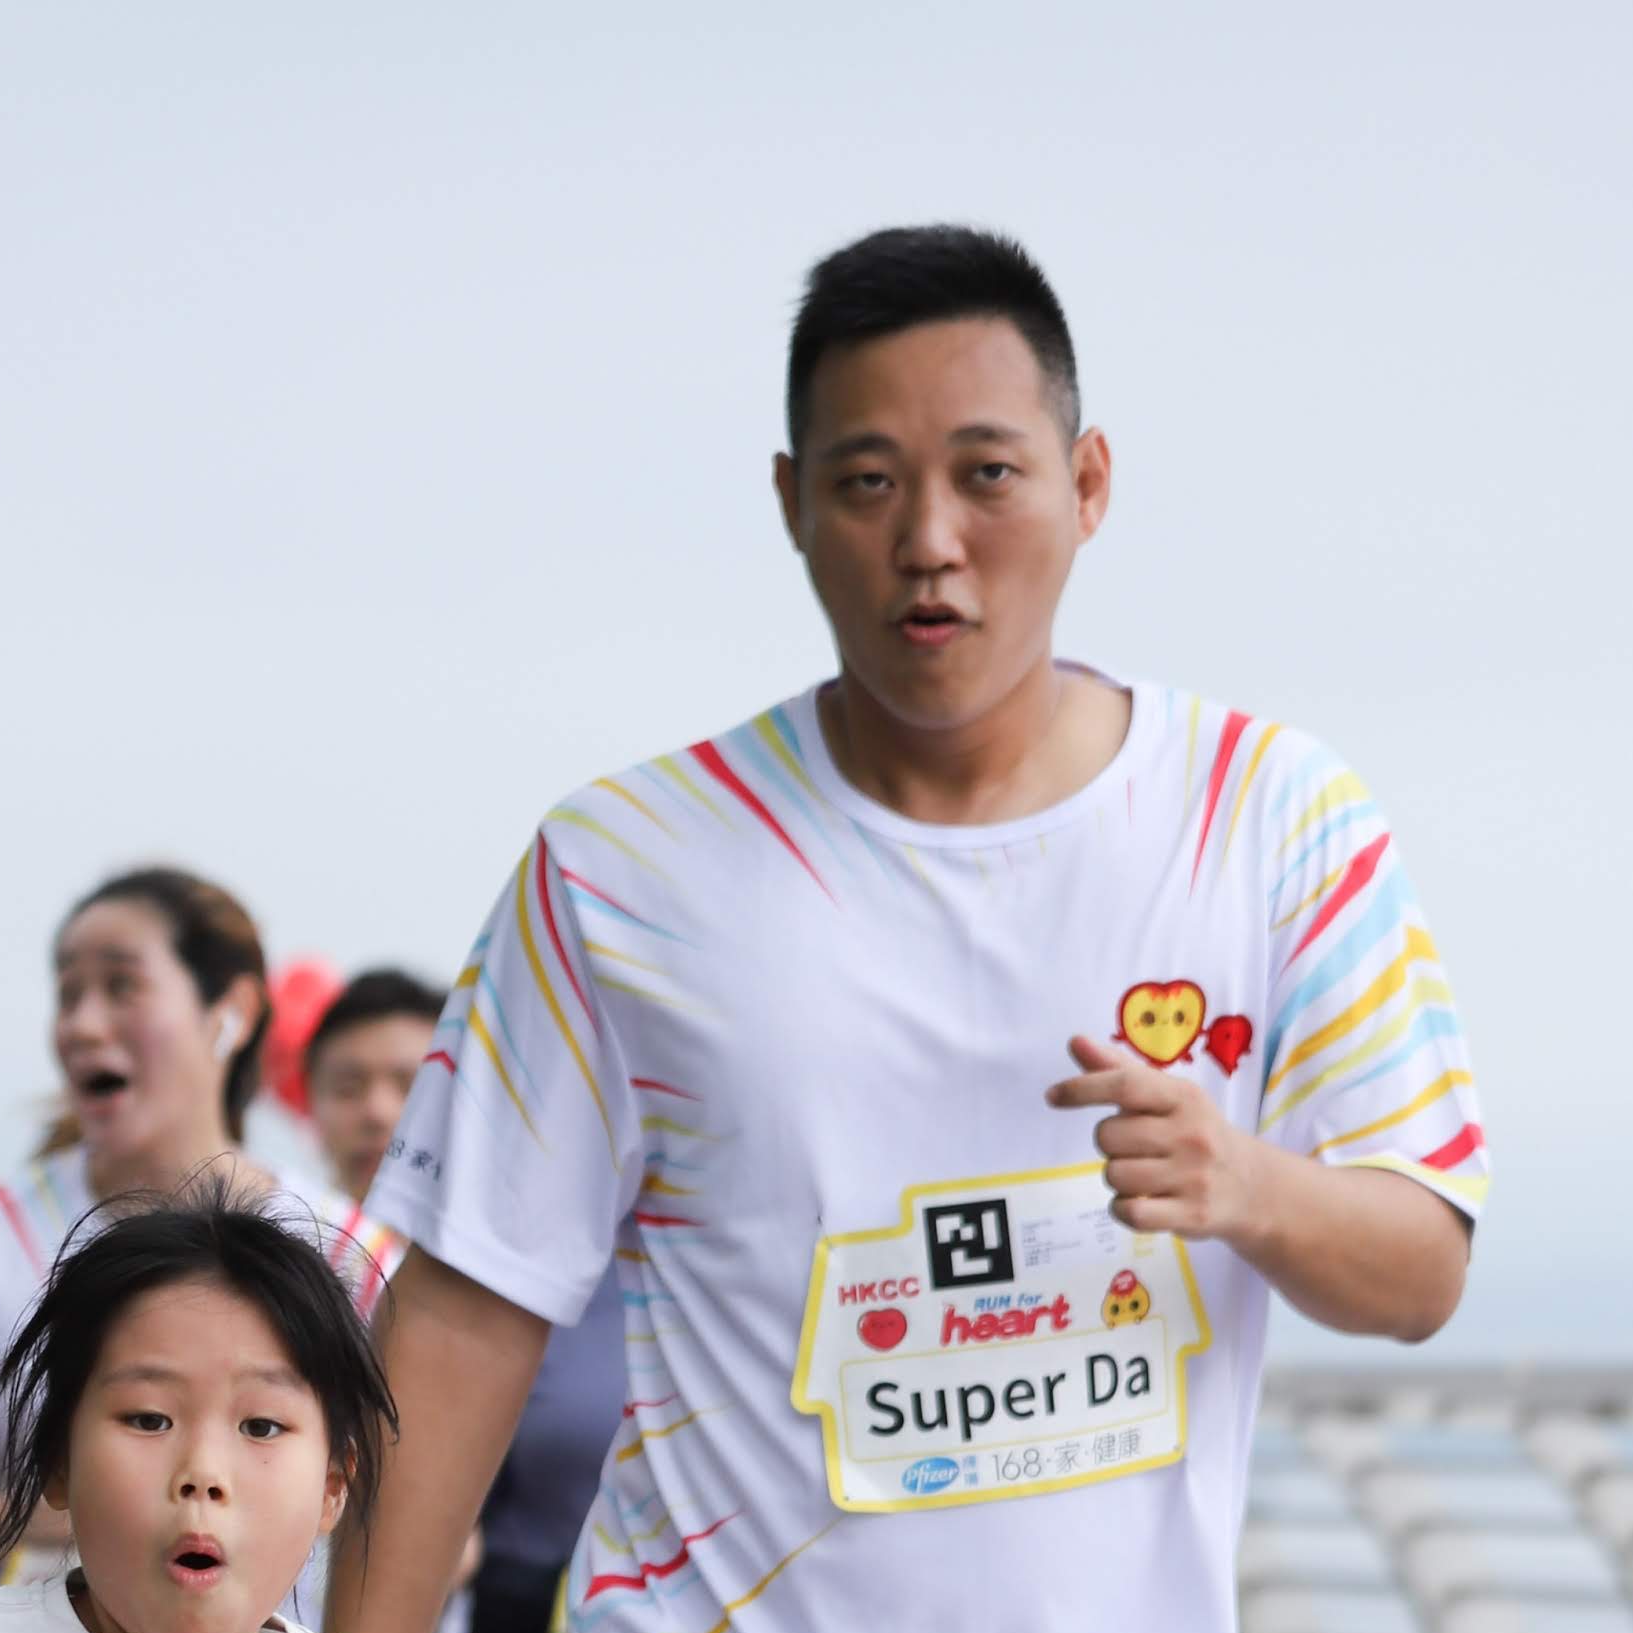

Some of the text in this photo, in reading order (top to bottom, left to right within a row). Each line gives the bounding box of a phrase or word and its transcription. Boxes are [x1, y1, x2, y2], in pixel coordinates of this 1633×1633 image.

[837, 1276, 921, 1306] HKCC
[974, 1292, 1044, 1311] RUN for
[940, 1293, 1073, 1348] heart
[866, 1352, 1151, 1441] Super Da
[903, 1460, 960, 1493] Pfizer
